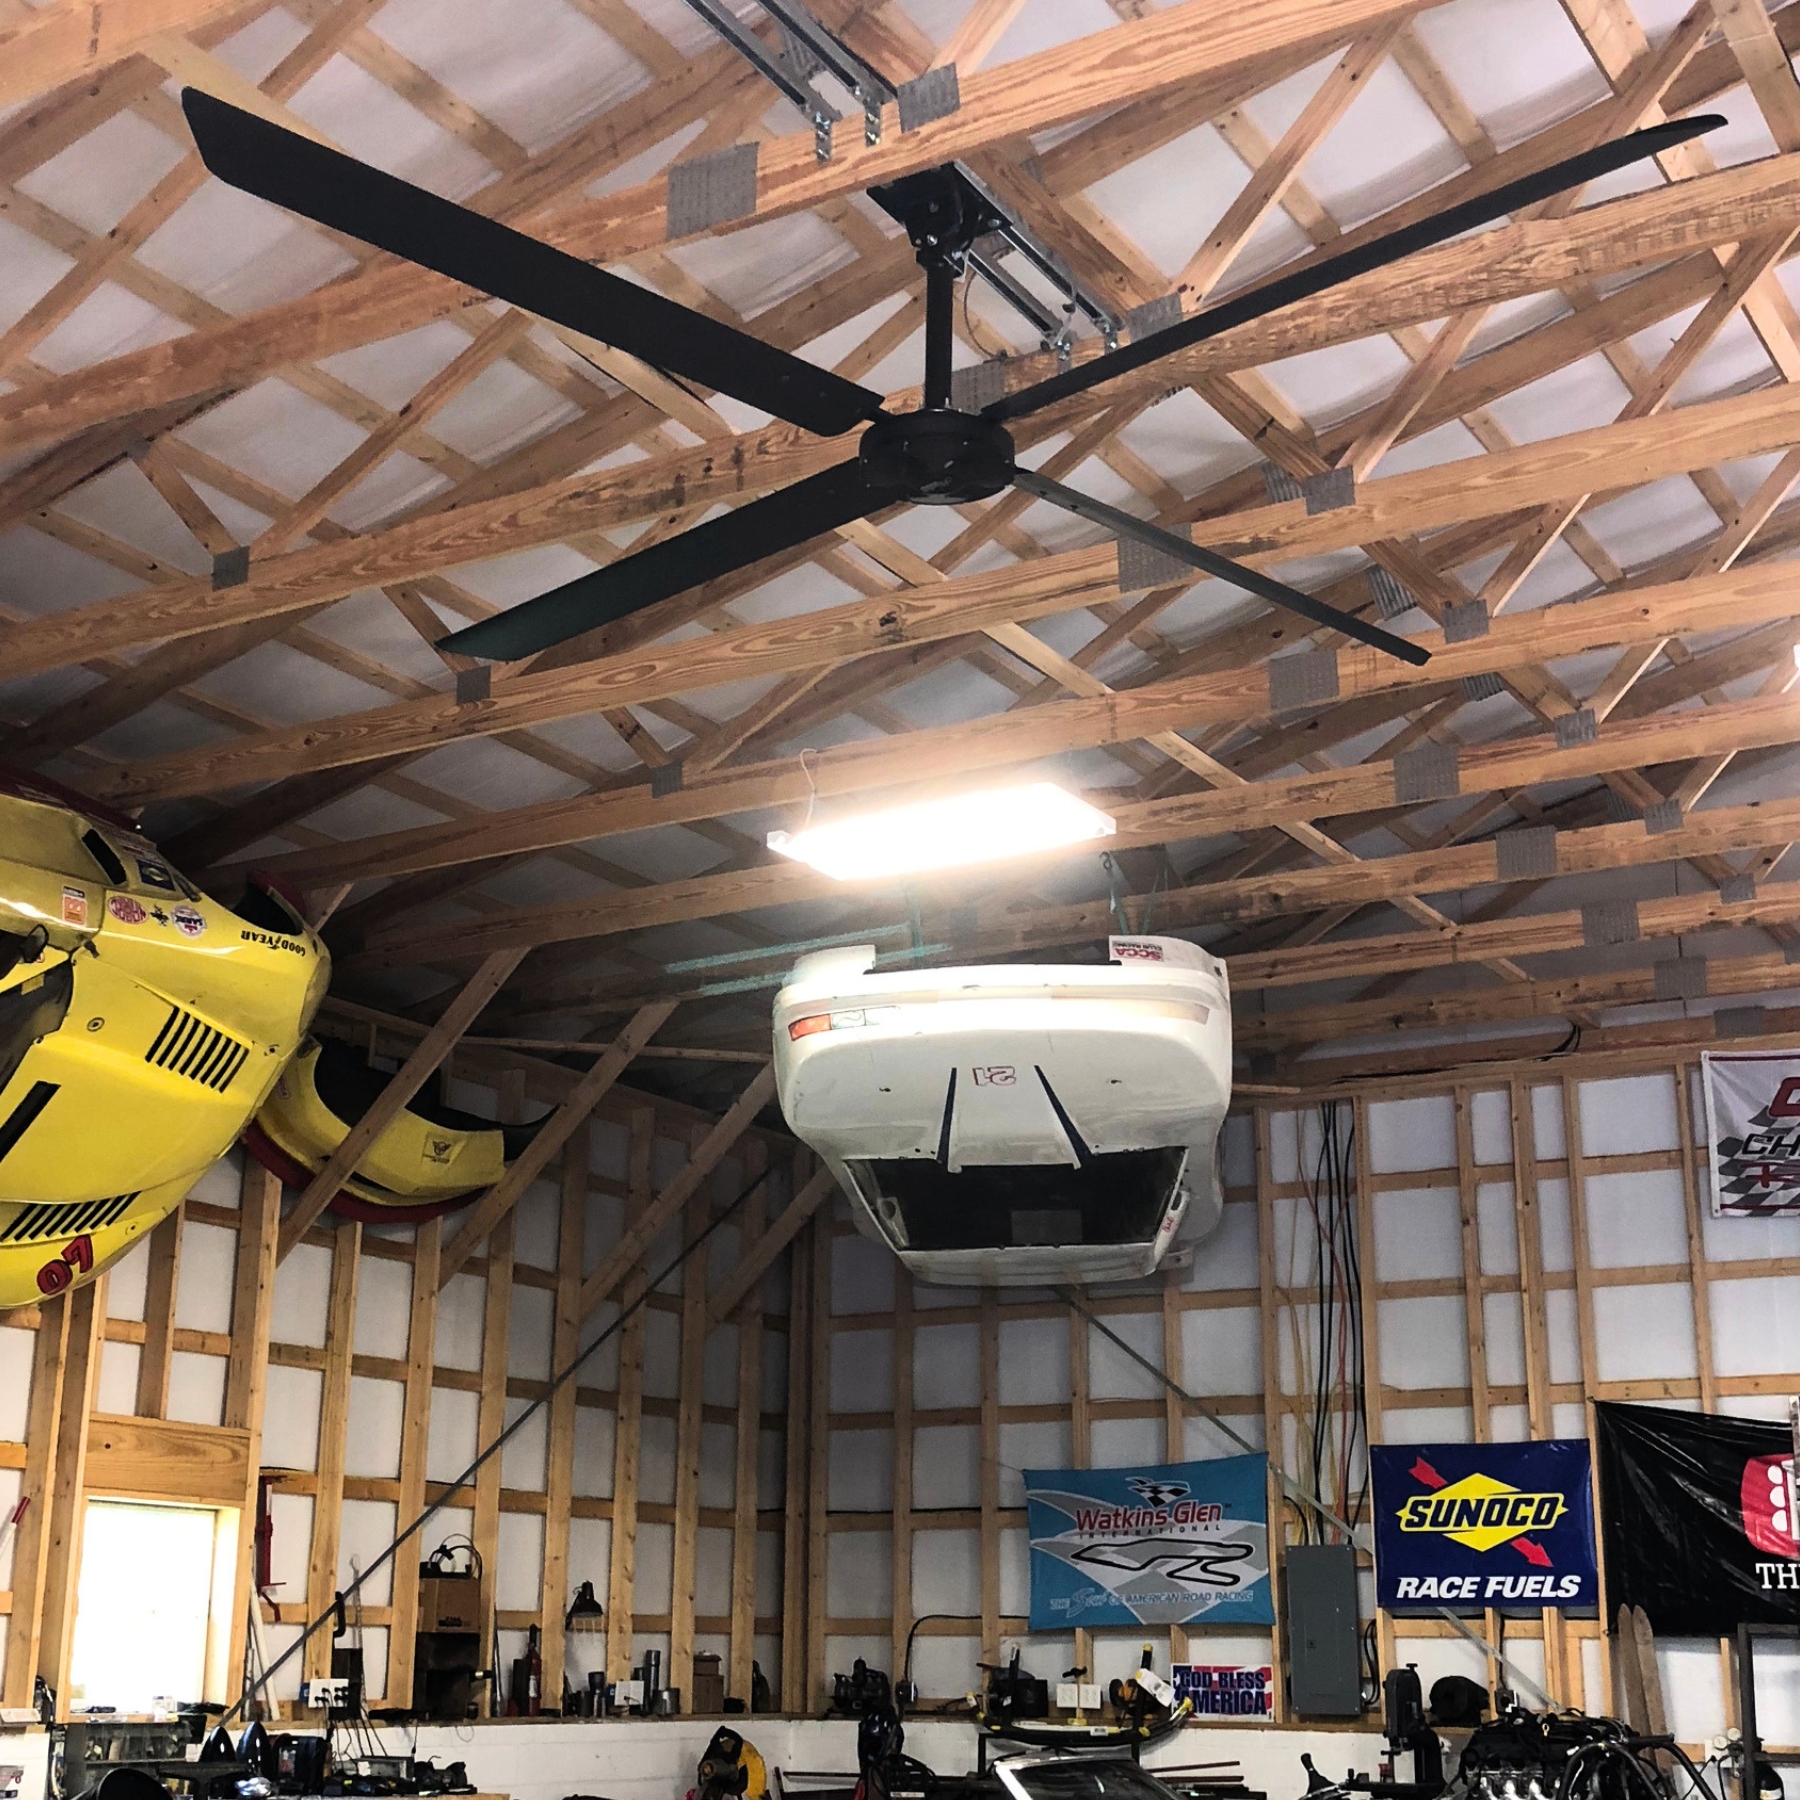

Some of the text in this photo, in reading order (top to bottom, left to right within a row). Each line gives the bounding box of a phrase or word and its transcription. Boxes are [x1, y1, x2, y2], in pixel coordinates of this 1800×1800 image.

[240, 930, 306, 957] GOODYEAR
[1115, 948, 1162, 960] SCCA
[972, 1065, 1018, 1087] 21
[36, 1234, 94, 1296] 07
[1075, 1500, 1223, 1532] Watkins Glen
[1404, 1497, 1560, 1529] SUNOCO
[1079, 1523, 1221, 1540] INTERNATIONAL
[1396, 1575, 1582, 1599] RACE FUELS
[1755, 1563, 1800, 1589] TH
[1108, 1595, 1126, 1606] OF
[1125, 1592, 1180, 1604] AMERICAN
[1183, 1591, 1212, 1602] ROAD
[1214, 1589, 1254, 1602] RACING
[1180, 1670, 1265, 1689] GOD BLESS
